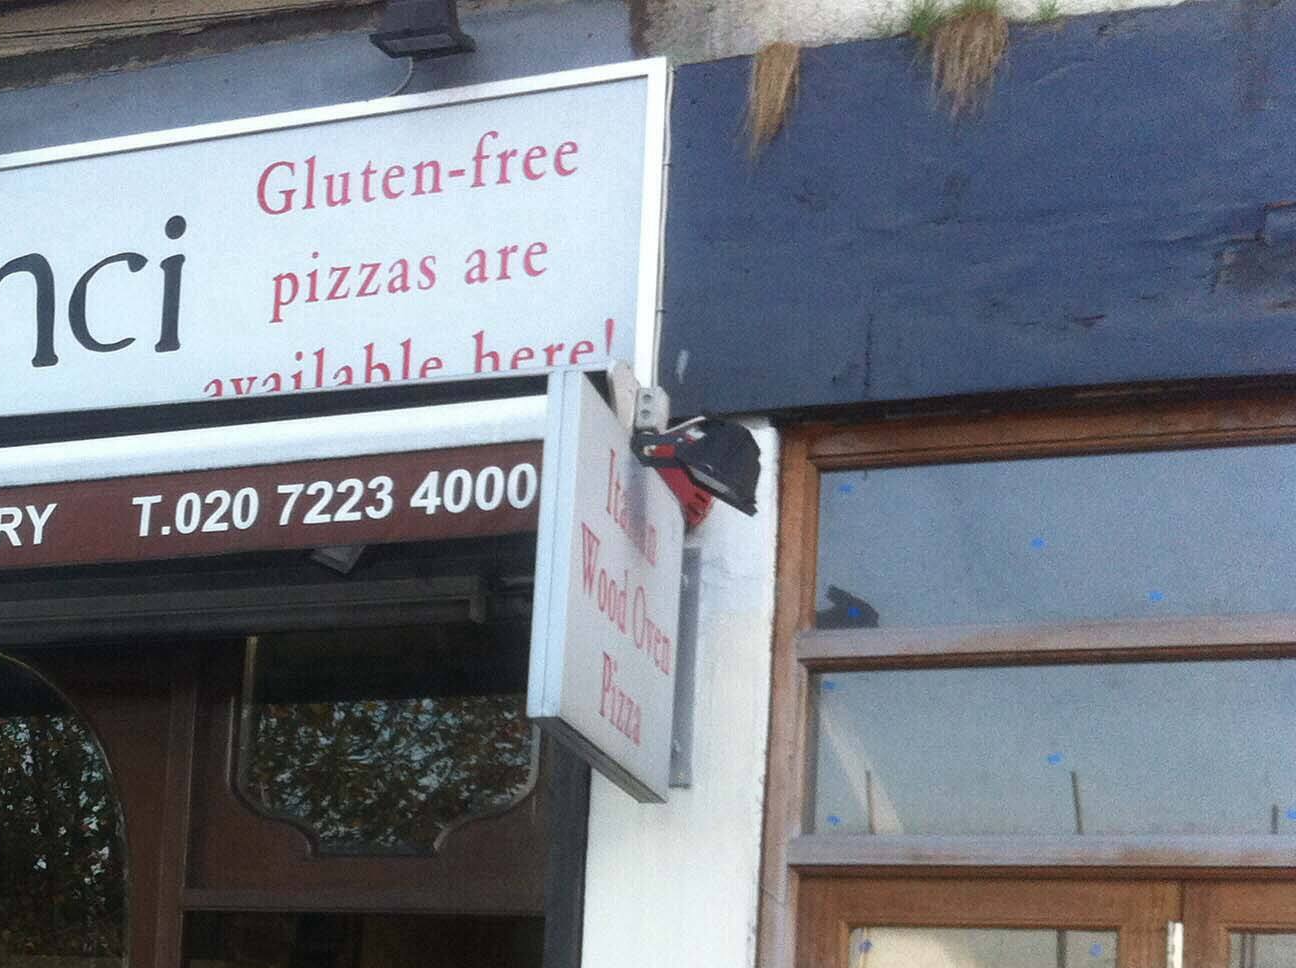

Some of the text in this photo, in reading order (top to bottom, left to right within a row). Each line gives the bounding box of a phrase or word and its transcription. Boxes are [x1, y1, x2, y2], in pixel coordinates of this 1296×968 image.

[256, 130, 579, 216] Gluten-free
[269, 240, 550, 323] pizzas are
[132, 463, 538, 537] T.020 7223 4000
[599, 651, 642, 747] Pizza
